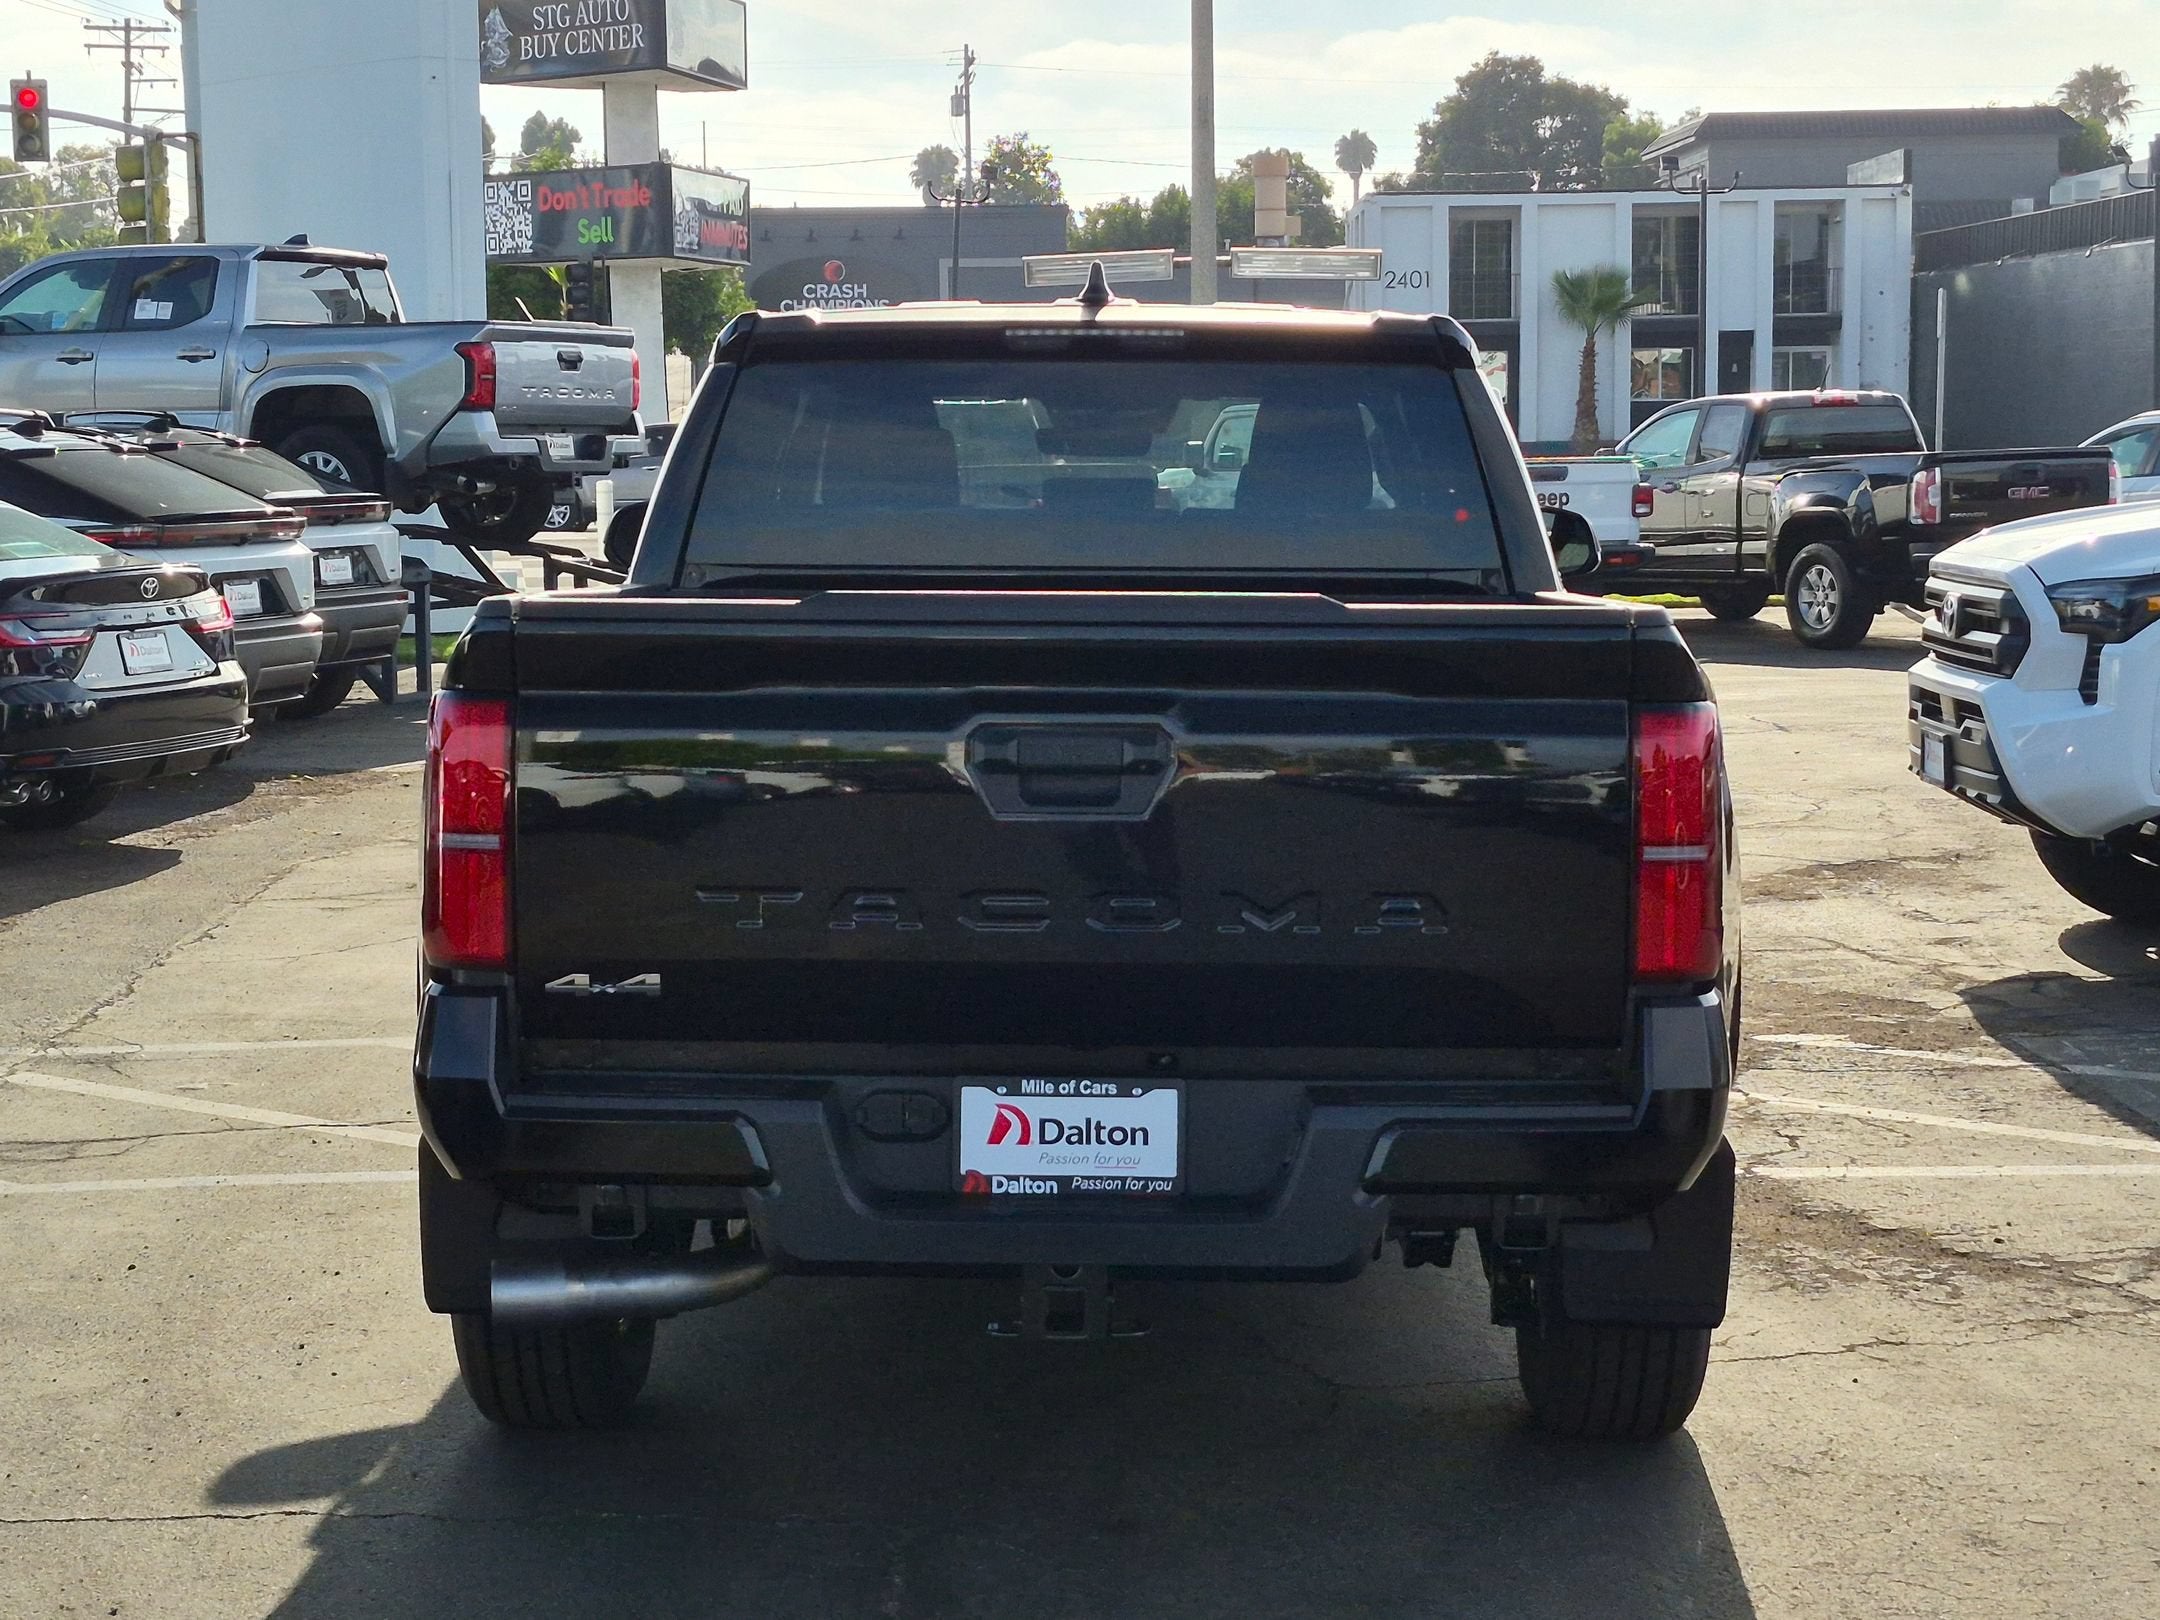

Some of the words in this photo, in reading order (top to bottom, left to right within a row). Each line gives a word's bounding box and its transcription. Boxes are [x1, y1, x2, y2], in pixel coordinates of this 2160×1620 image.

[532, 4, 571, 31] STG
[575, 0, 630, 25] AUTO
[519, 33, 561, 61] BUY
[564, 23, 645, 56] CENTER
[537, 182, 590, 213] Don't
[592, 178, 652, 209] Trade
[577, 216, 615, 245] Sell
[1384, 270, 1430, 289] 2401
[802, 283, 867, 299] CRASH
[521, 386, 616, 400] TACOMA
[1537, 491, 1570, 510] eep
[2007, 485, 2050, 499] GMC
[695, 886, 1449, 935] TACOMA
[544, 973, 661, 997] 4x4
[1021, 1079, 1054, 1095] Mile
[1058, 1080, 1076, 1095] of
[1079, 1080, 1118, 1096] Cars
[1038, 1117, 1149, 1147] Dalton
[1038, 1151, 1090, 1166] Passion
[1093, 1151, 1114, 1166] for
[1116, 1155, 1141, 1168] you
[991, 1176, 1058, 1194] Dalton
[1071, 1176, 1123, 1191] Passion
[1125, 1176, 1144, 1191] for
[1148, 1179, 1173, 1194] you
